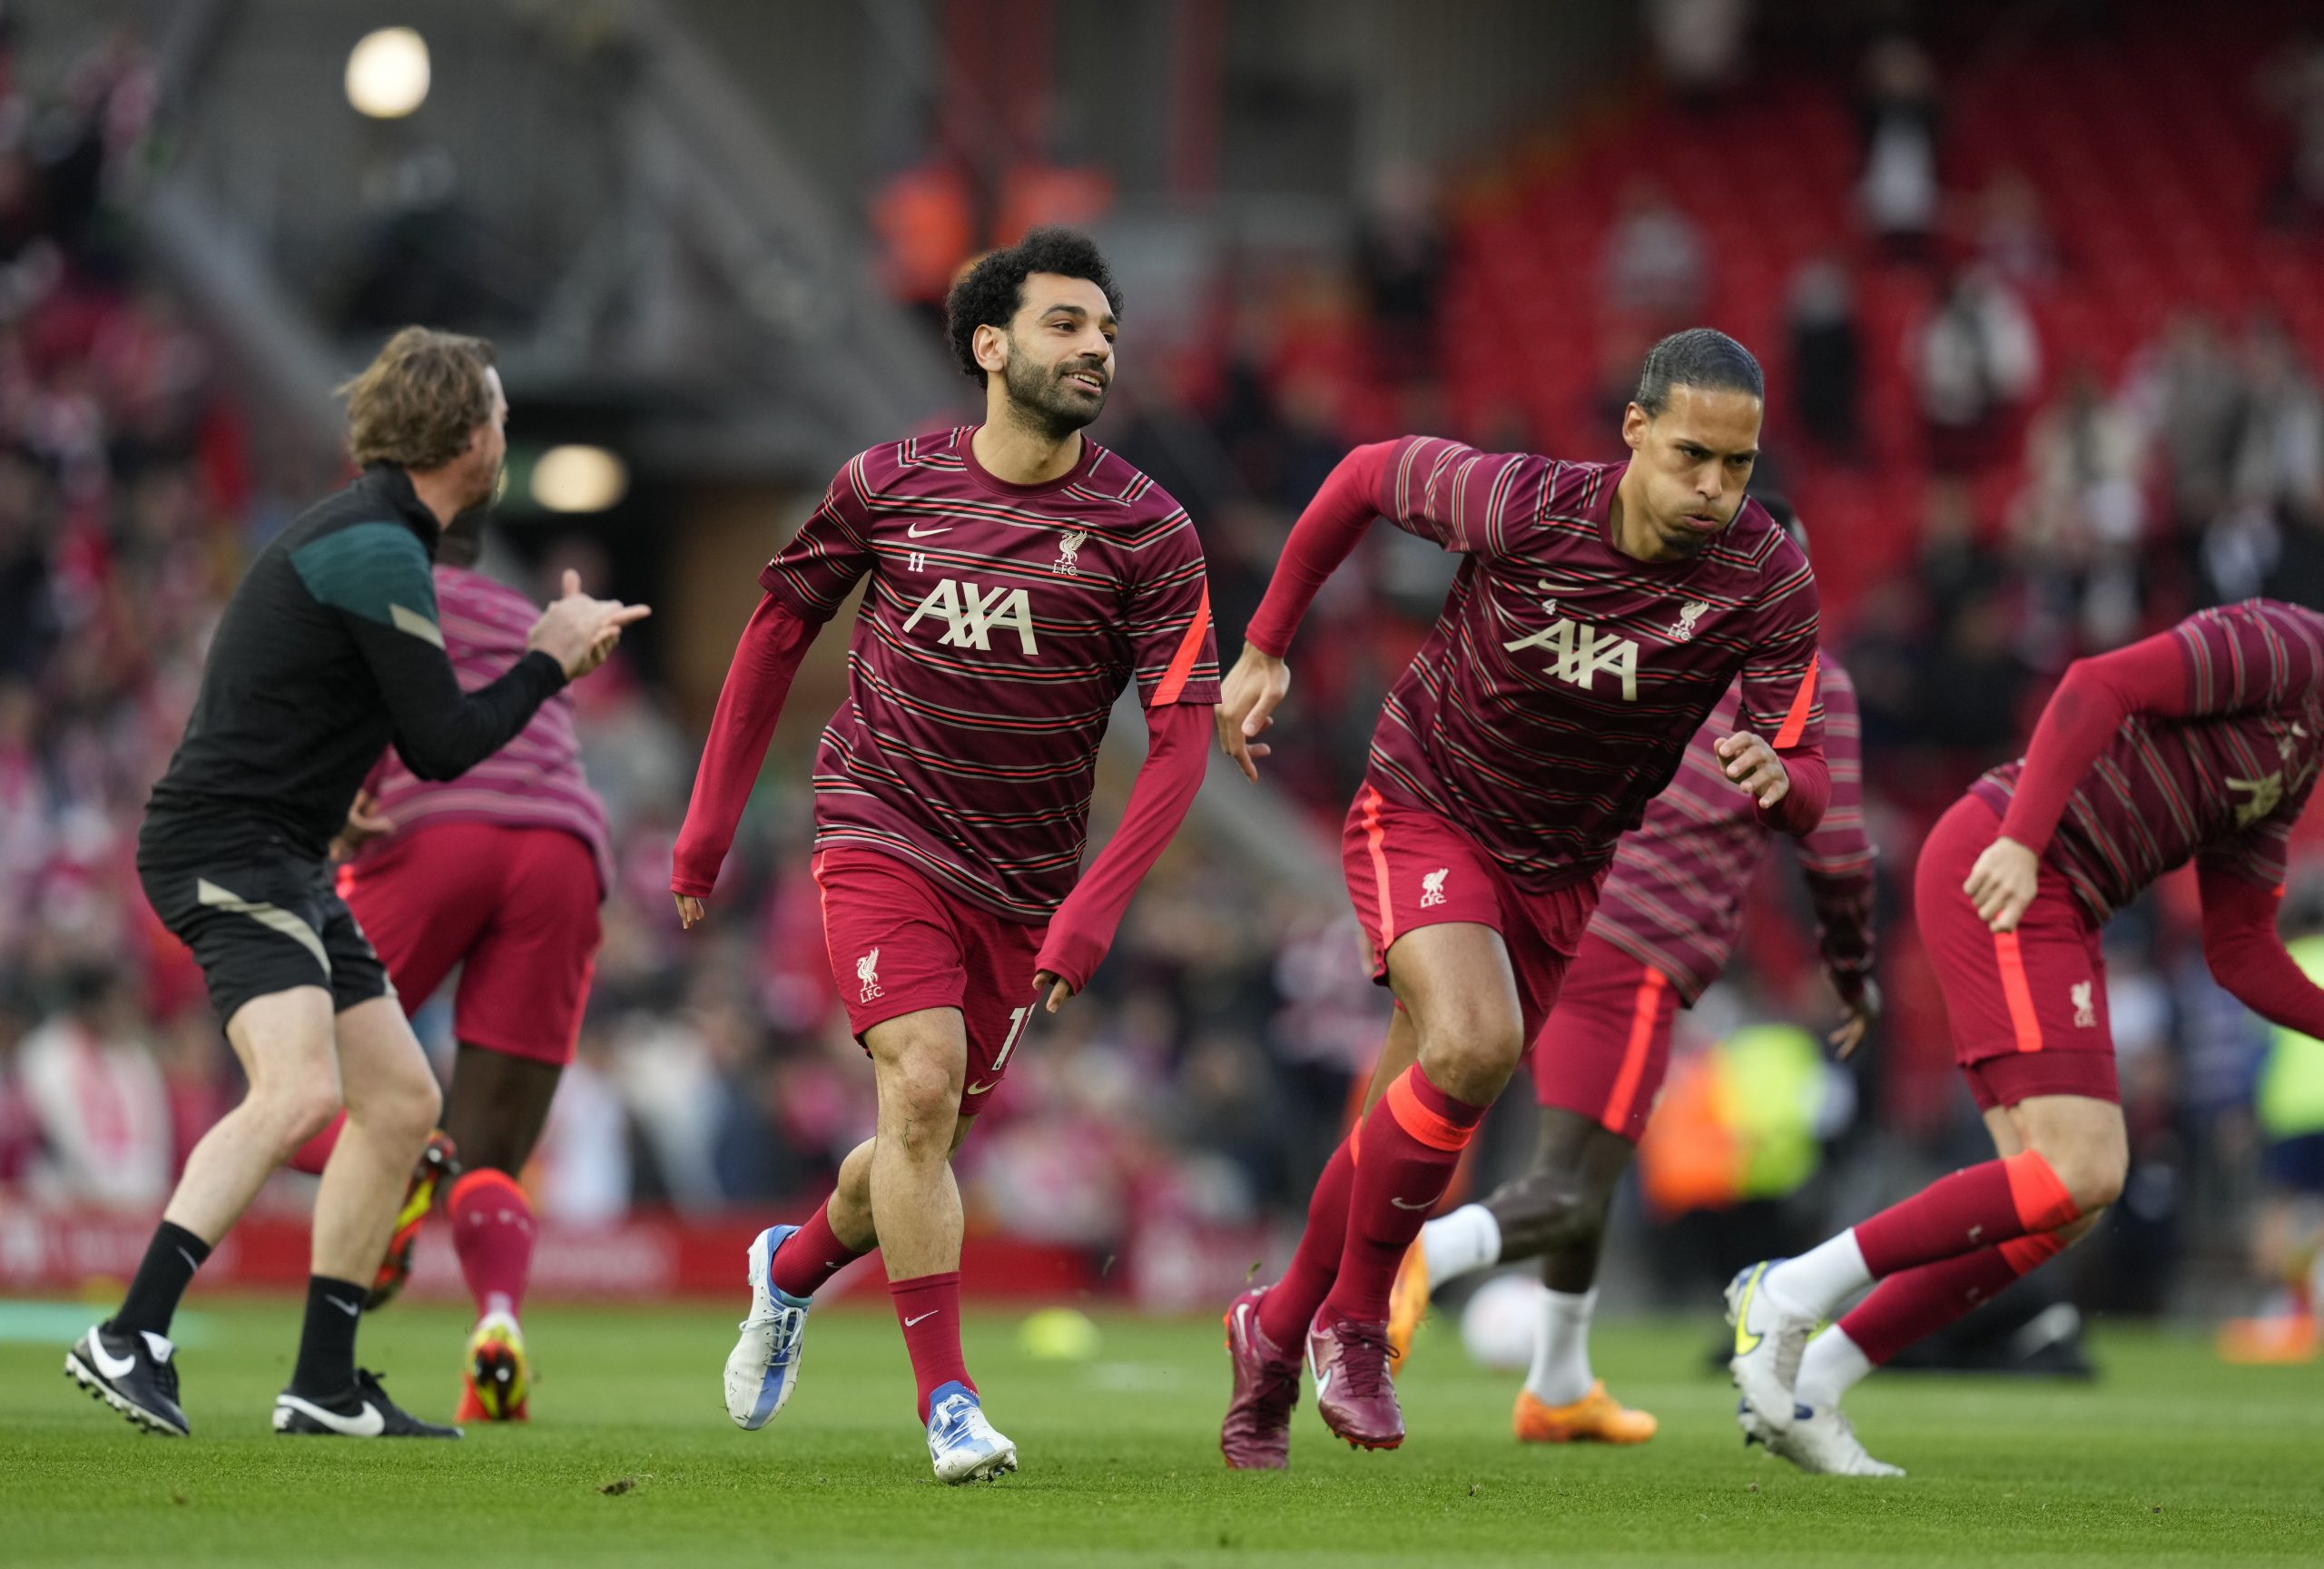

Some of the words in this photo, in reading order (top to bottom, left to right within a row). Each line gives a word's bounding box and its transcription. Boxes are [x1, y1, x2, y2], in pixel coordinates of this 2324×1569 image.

[908, 551, 926, 573] 11
[901, 578, 1039, 656] AXA
[1541, 597, 1558, 616] 4
[1502, 617, 1640, 702] AXA
